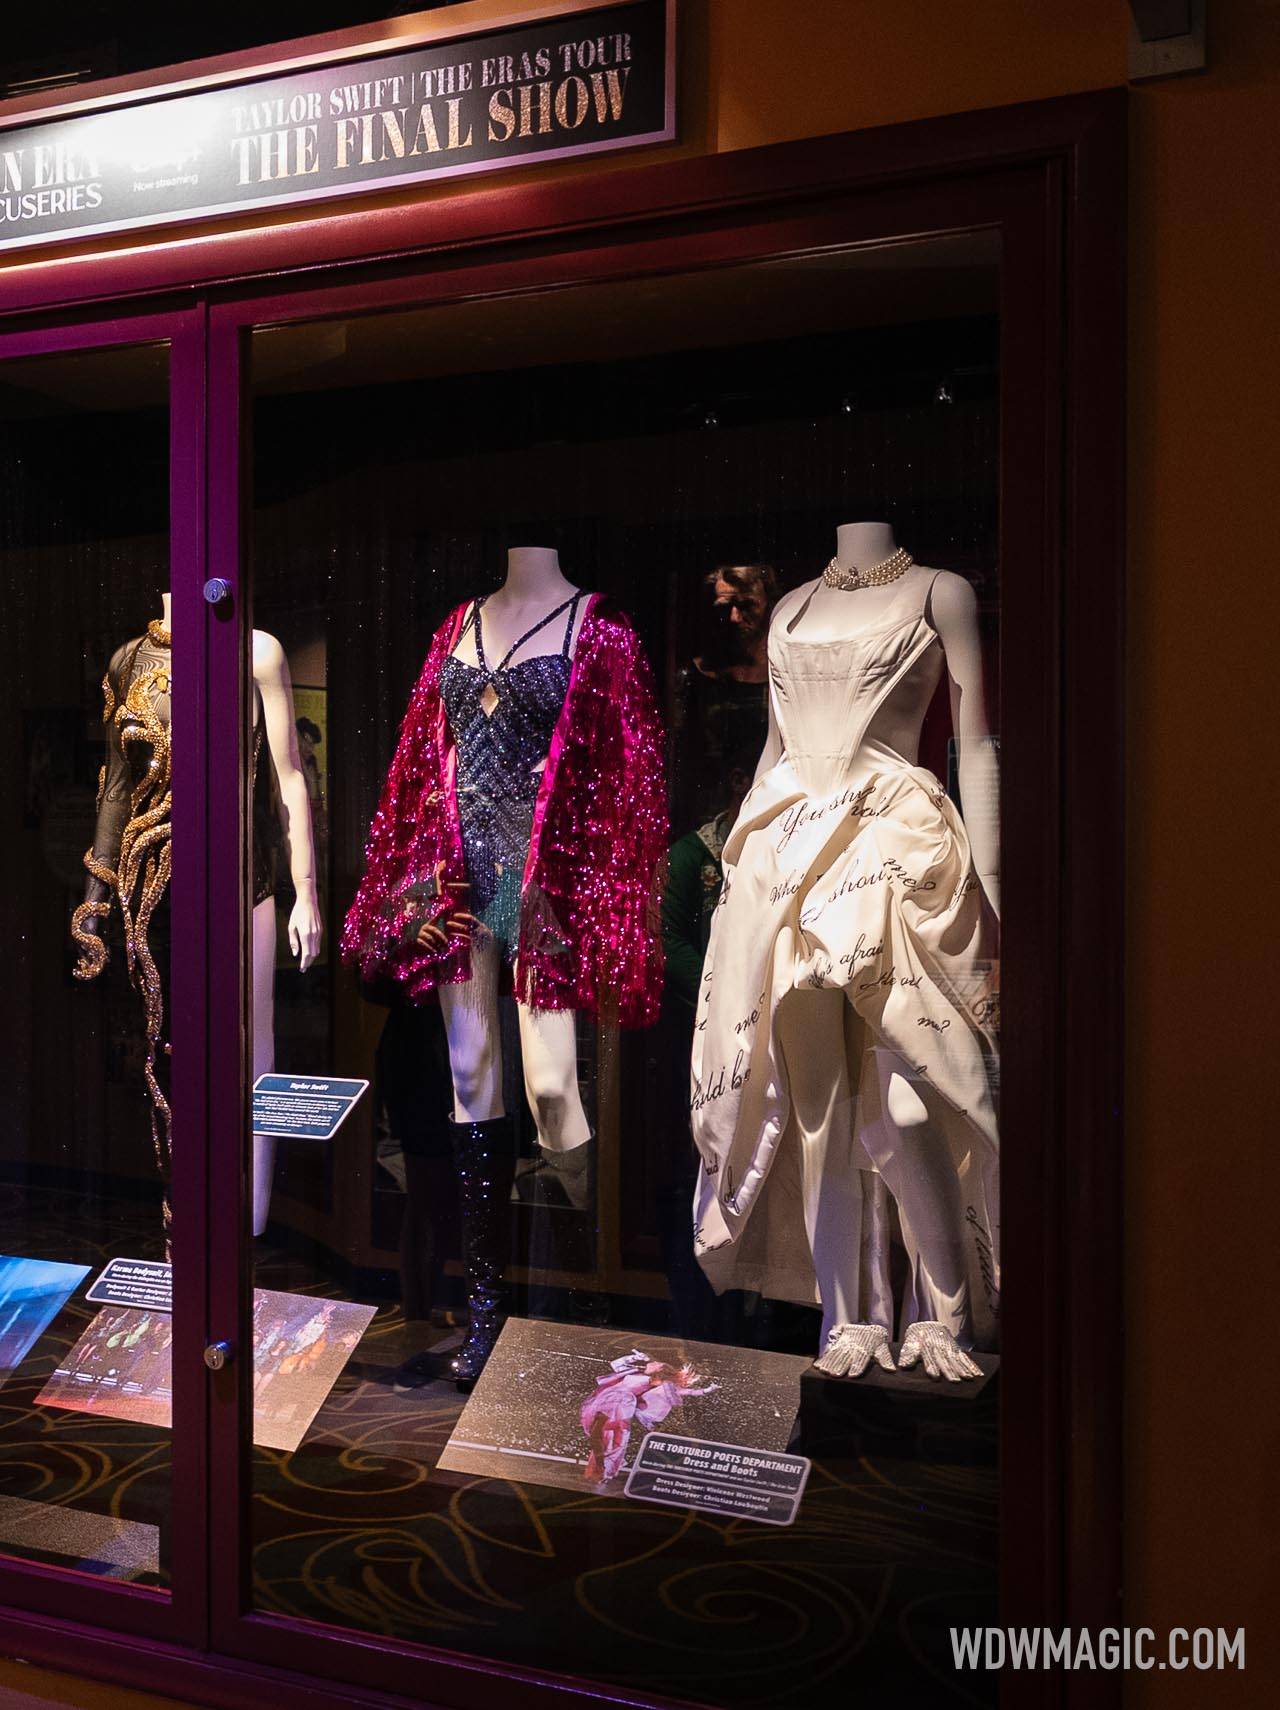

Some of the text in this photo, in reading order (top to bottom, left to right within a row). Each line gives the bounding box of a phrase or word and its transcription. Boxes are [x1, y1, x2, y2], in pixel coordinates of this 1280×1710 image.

[233, 93, 322, 133] TAYLOR
[329, 75, 404, 116] SWIFT
[421, 63, 472, 99] THE
[480, 47, 551, 88] ERAS
[559, 33, 632, 73] TOUR
[231, 67, 632, 186] THE FINAL SHOW
[290, 1082, 329, 1091] Taylor Swift
[111, 1265, 133, 1274] Karma
[648, 1440, 803, 1474] THE TORTURED POETS DEPARTMENT
[683, 1456, 758, 1477] Dress and Boots
[656, 1477, 674, 1486] Dress
[675, 1481, 705, 1492] Designer:
[652, 1485, 671, 1493] Boots
[671, 1489, 702, 1500] Designer:
[703, 1494, 733, 1505] Christian
